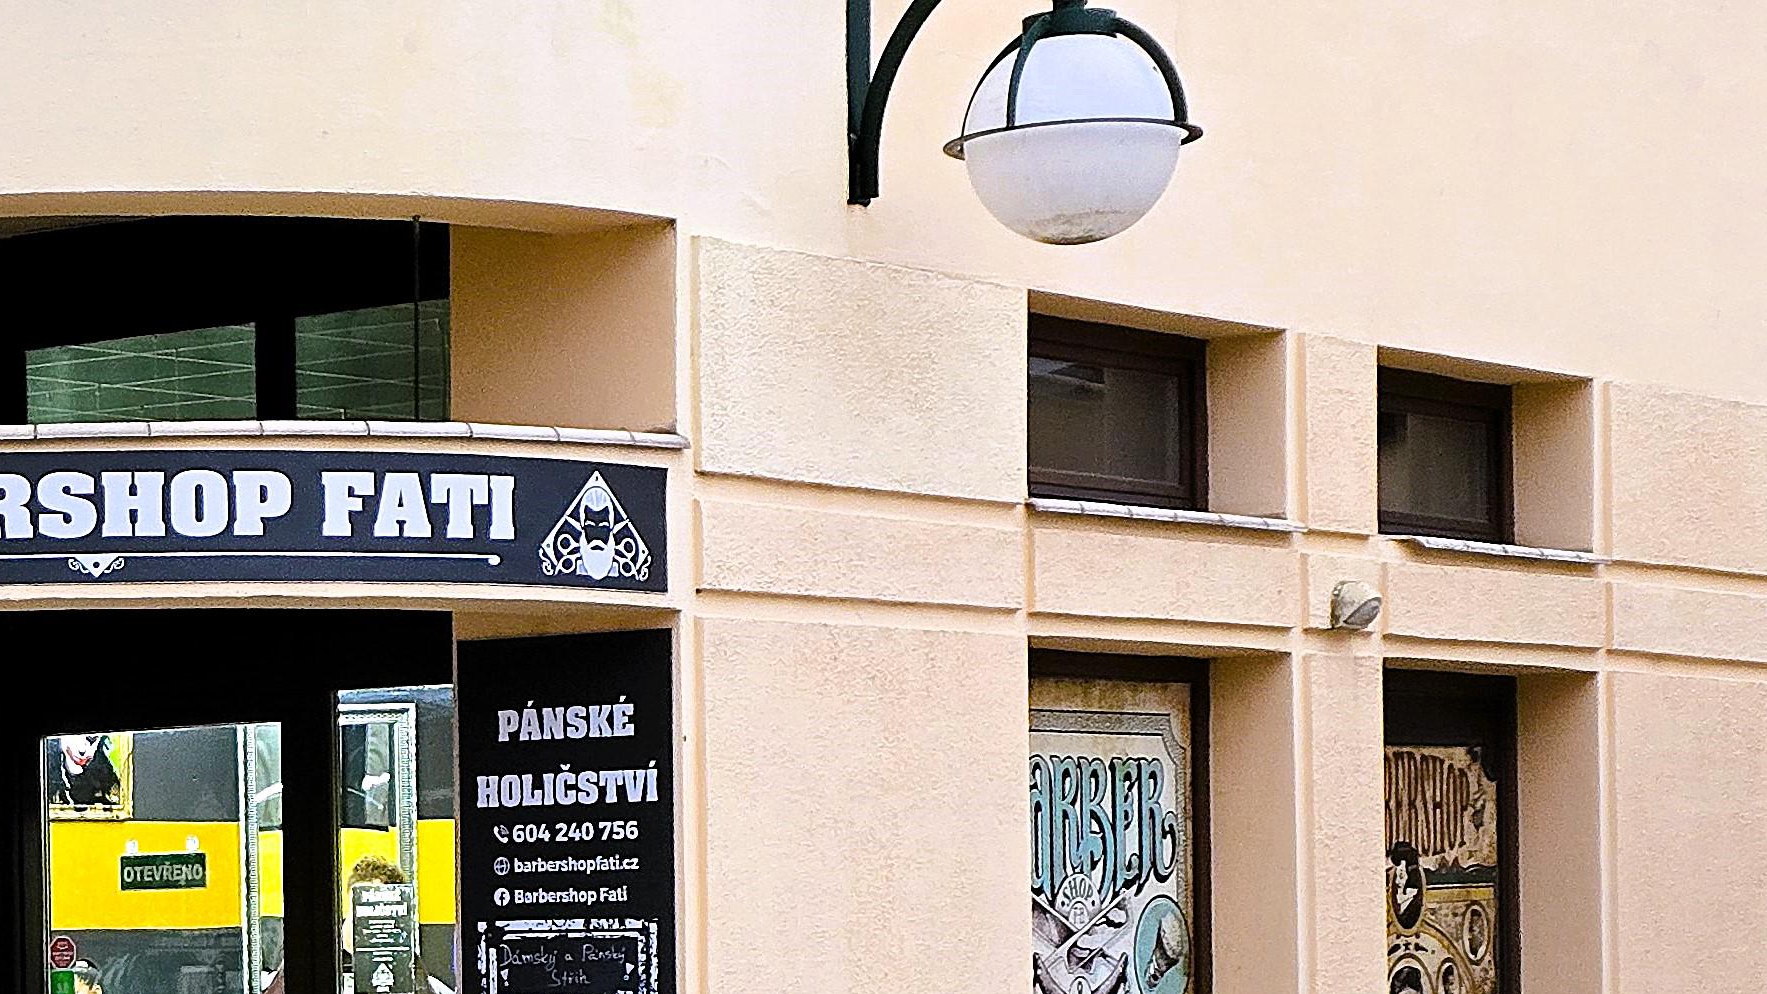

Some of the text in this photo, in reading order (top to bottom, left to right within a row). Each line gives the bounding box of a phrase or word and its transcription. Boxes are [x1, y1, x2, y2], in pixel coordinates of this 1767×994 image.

[322, 472, 517, 542] FATI
[498, 695, 634, 742] PÁNSKÉ
[477, 760, 659, 808] HOLIČSTVÍ
[1385, 750, 1470, 857] BERSHOP
[513, 820, 639, 842] 604 240 756
[1029, 755, 1178, 900] ARBER
[123, 860, 203, 883] OTEVŘENO
[514, 853, 640, 875] barbershopfati.cz
[514, 885, 628, 906] Barbershop Fati
[1062, 876, 1094, 901] SHOP
[499, 944, 558, 971] Dámský
[564, 953, 574, 962] a
